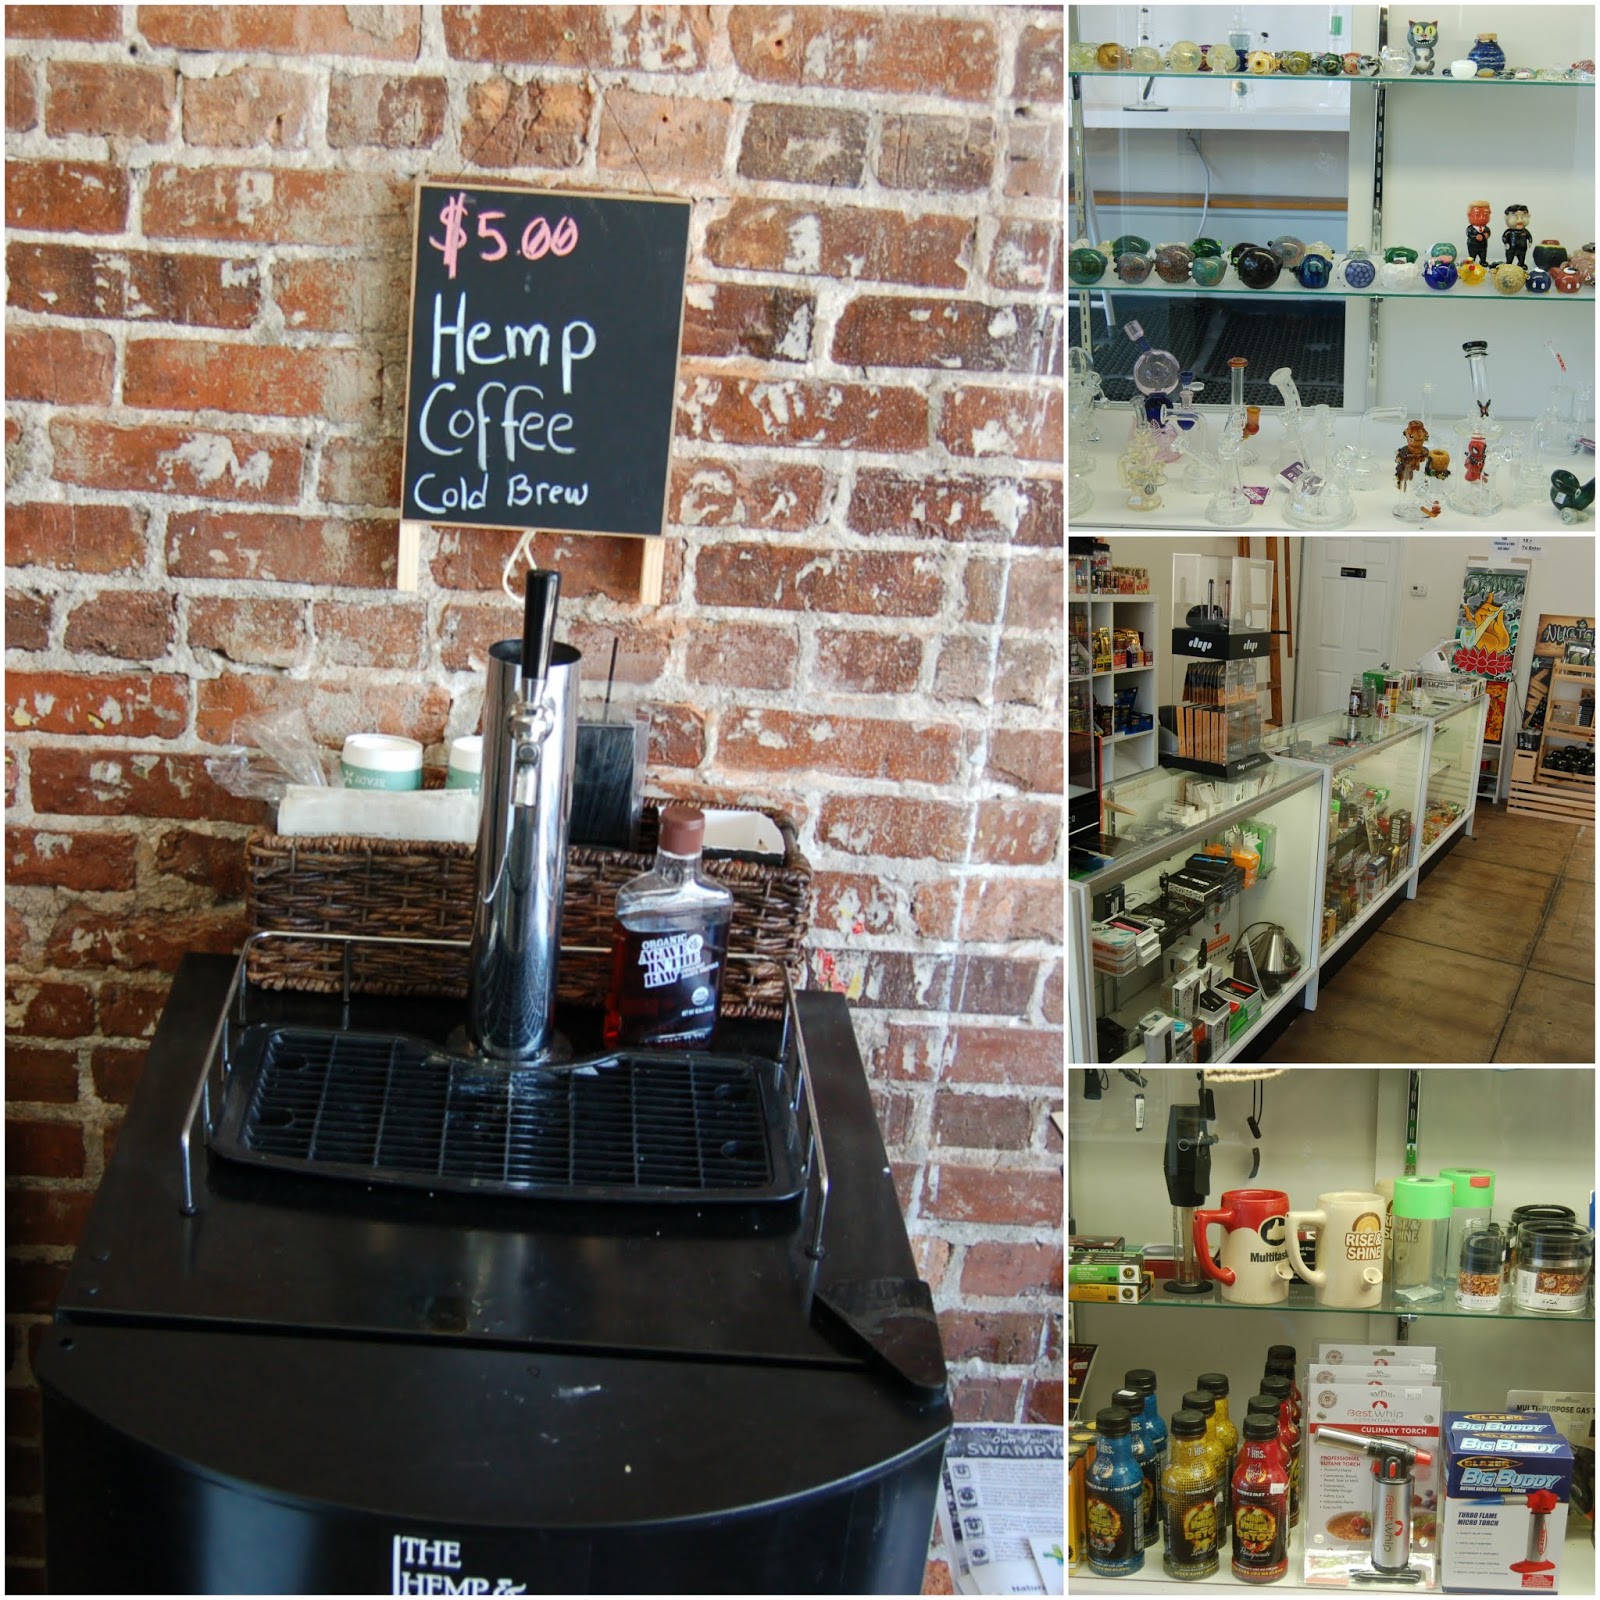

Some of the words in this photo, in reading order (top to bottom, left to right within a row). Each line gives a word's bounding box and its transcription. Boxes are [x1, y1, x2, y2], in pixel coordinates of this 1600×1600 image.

[429, 193, 579, 279] $5.00
[432, 292, 597, 394] Hemp
[419, 382, 577, 472] Coffee
[414, 473, 489, 514] Cold
[507, 473, 589, 508] Brew
[641, 933, 688, 950] ORGANIC
[644, 971, 679, 988] RAW
[1345, 1233, 1375, 1247] RISE
[1375, 1232, 1383, 1246] &
[1347, 1246, 1382, 1260] SHINE
[1516, 1404, 1575, 1413] MULTI-PURPOSE
[1460, 1468, 1497, 1487] BIG
[1494, 1469, 1562, 1489] BUDDY
[1237, 1529, 1274, 1541] DETOX
[401, 1536, 462, 1568] THE
